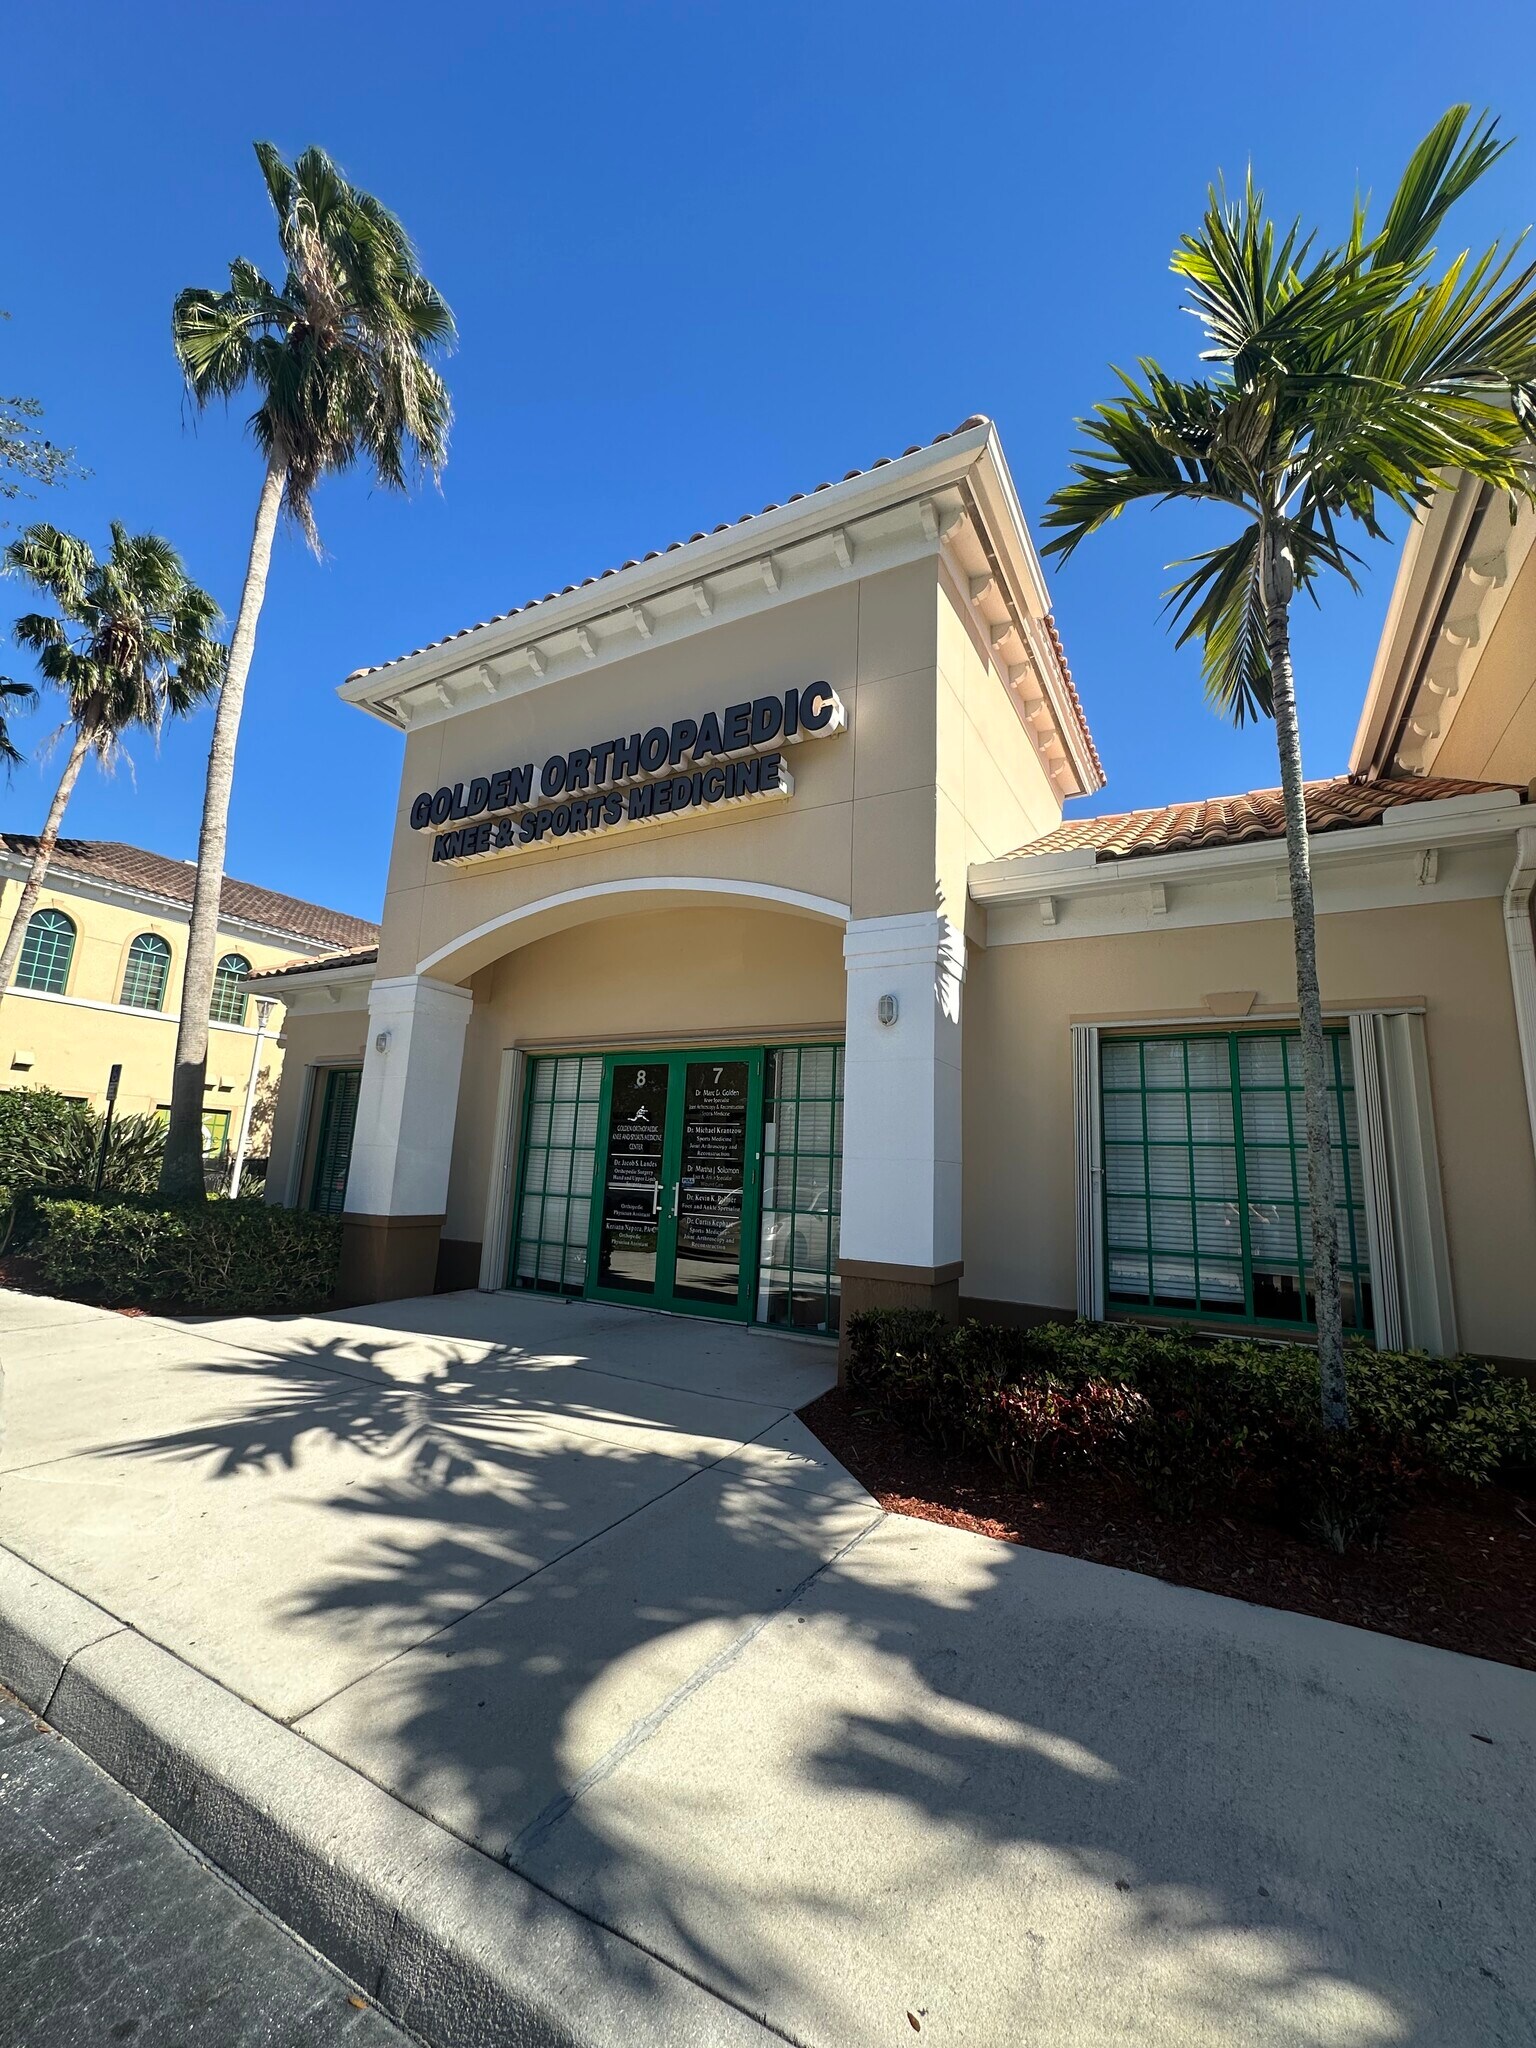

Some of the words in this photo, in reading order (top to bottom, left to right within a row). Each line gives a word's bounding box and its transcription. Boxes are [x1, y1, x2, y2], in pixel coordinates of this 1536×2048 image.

[410, 764, 534, 831] GOLDEN
[540, 680, 834, 797] ORTHOPAEDIC
[432, 822, 491, 862] KNEE
[496, 819, 516, 848] &
[519, 792, 623, 844] SPORTS
[628, 753, 782, 819] MEDICINE
[637, 1070, 646, 1086] 8
[713, 1068, 723, 1083] 7
[622, 1159, 635, 1167] Jacob
[717, 1166, 739, 1174] Solomon
